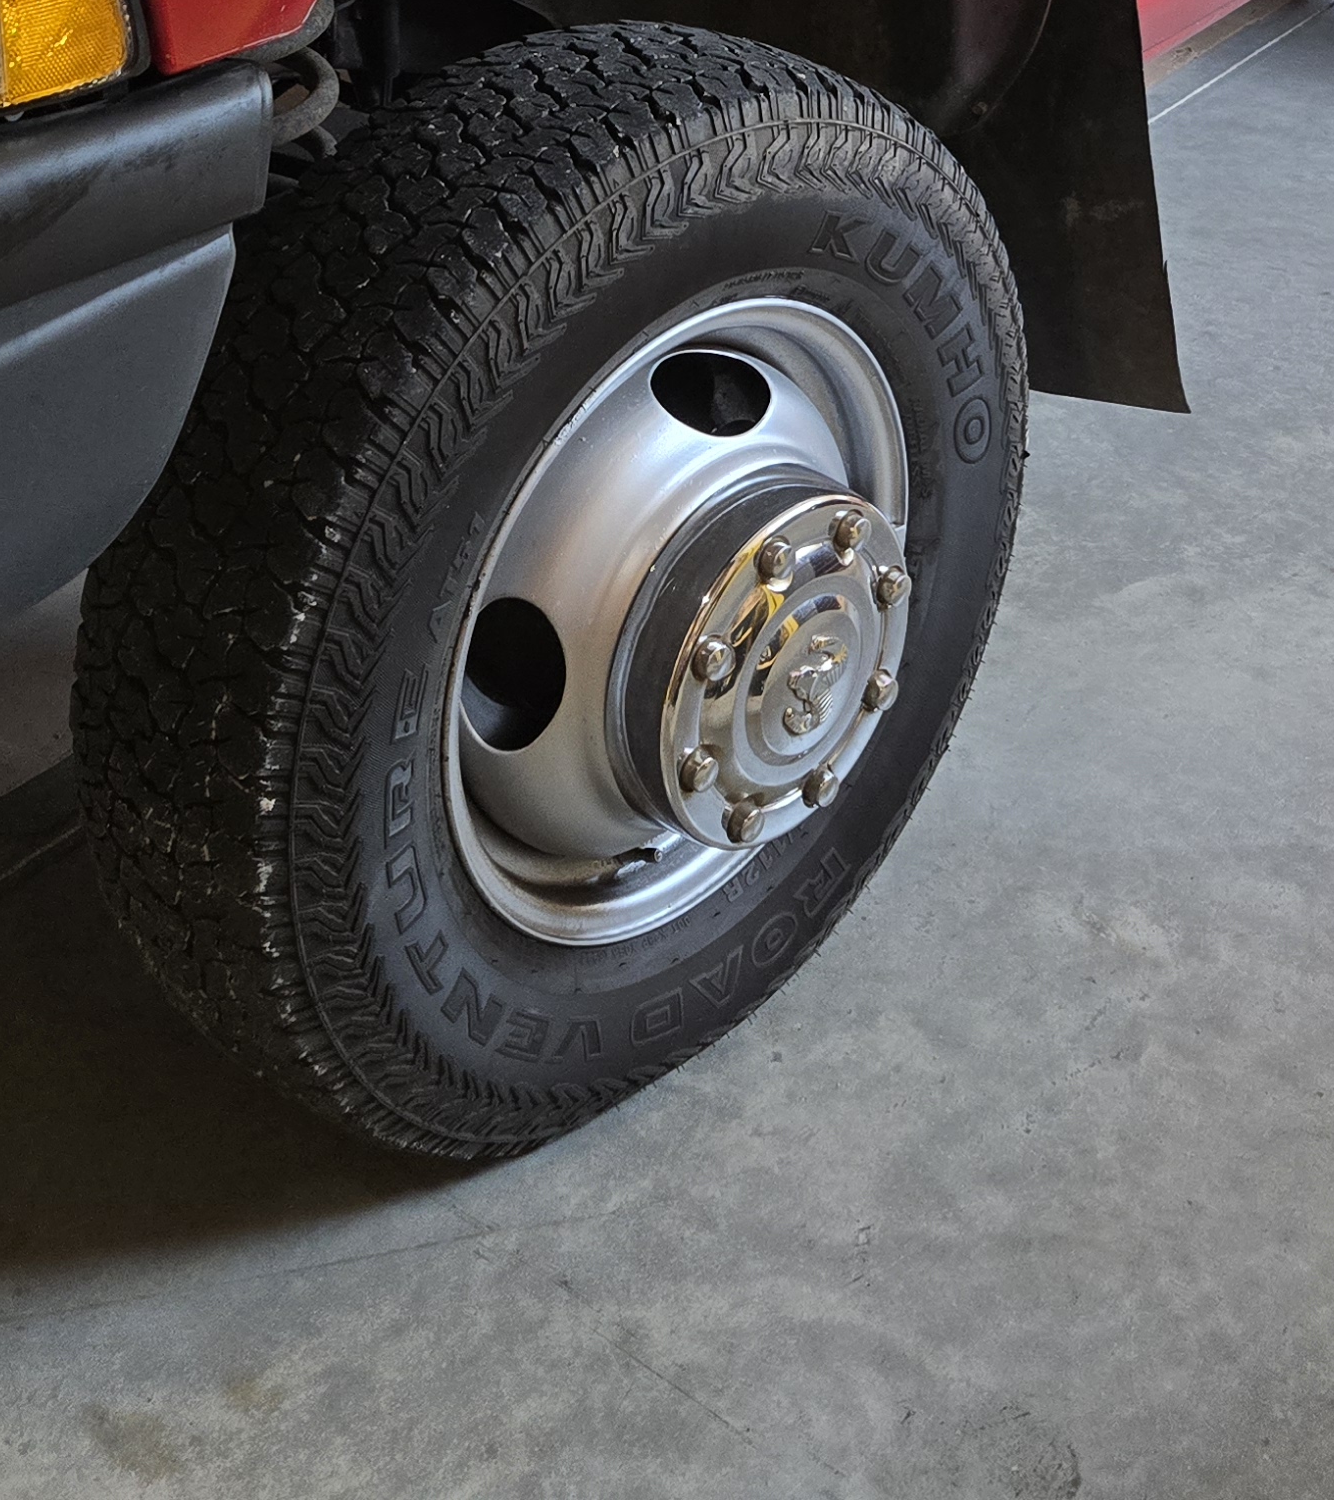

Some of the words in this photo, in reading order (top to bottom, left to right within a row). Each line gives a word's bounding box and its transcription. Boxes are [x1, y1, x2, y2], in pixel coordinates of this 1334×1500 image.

[808, 209, 993, 465] KUMHO
[383, 662, 604, 1063] VENTURE
[629, 847, 852, 1047] ROAD
